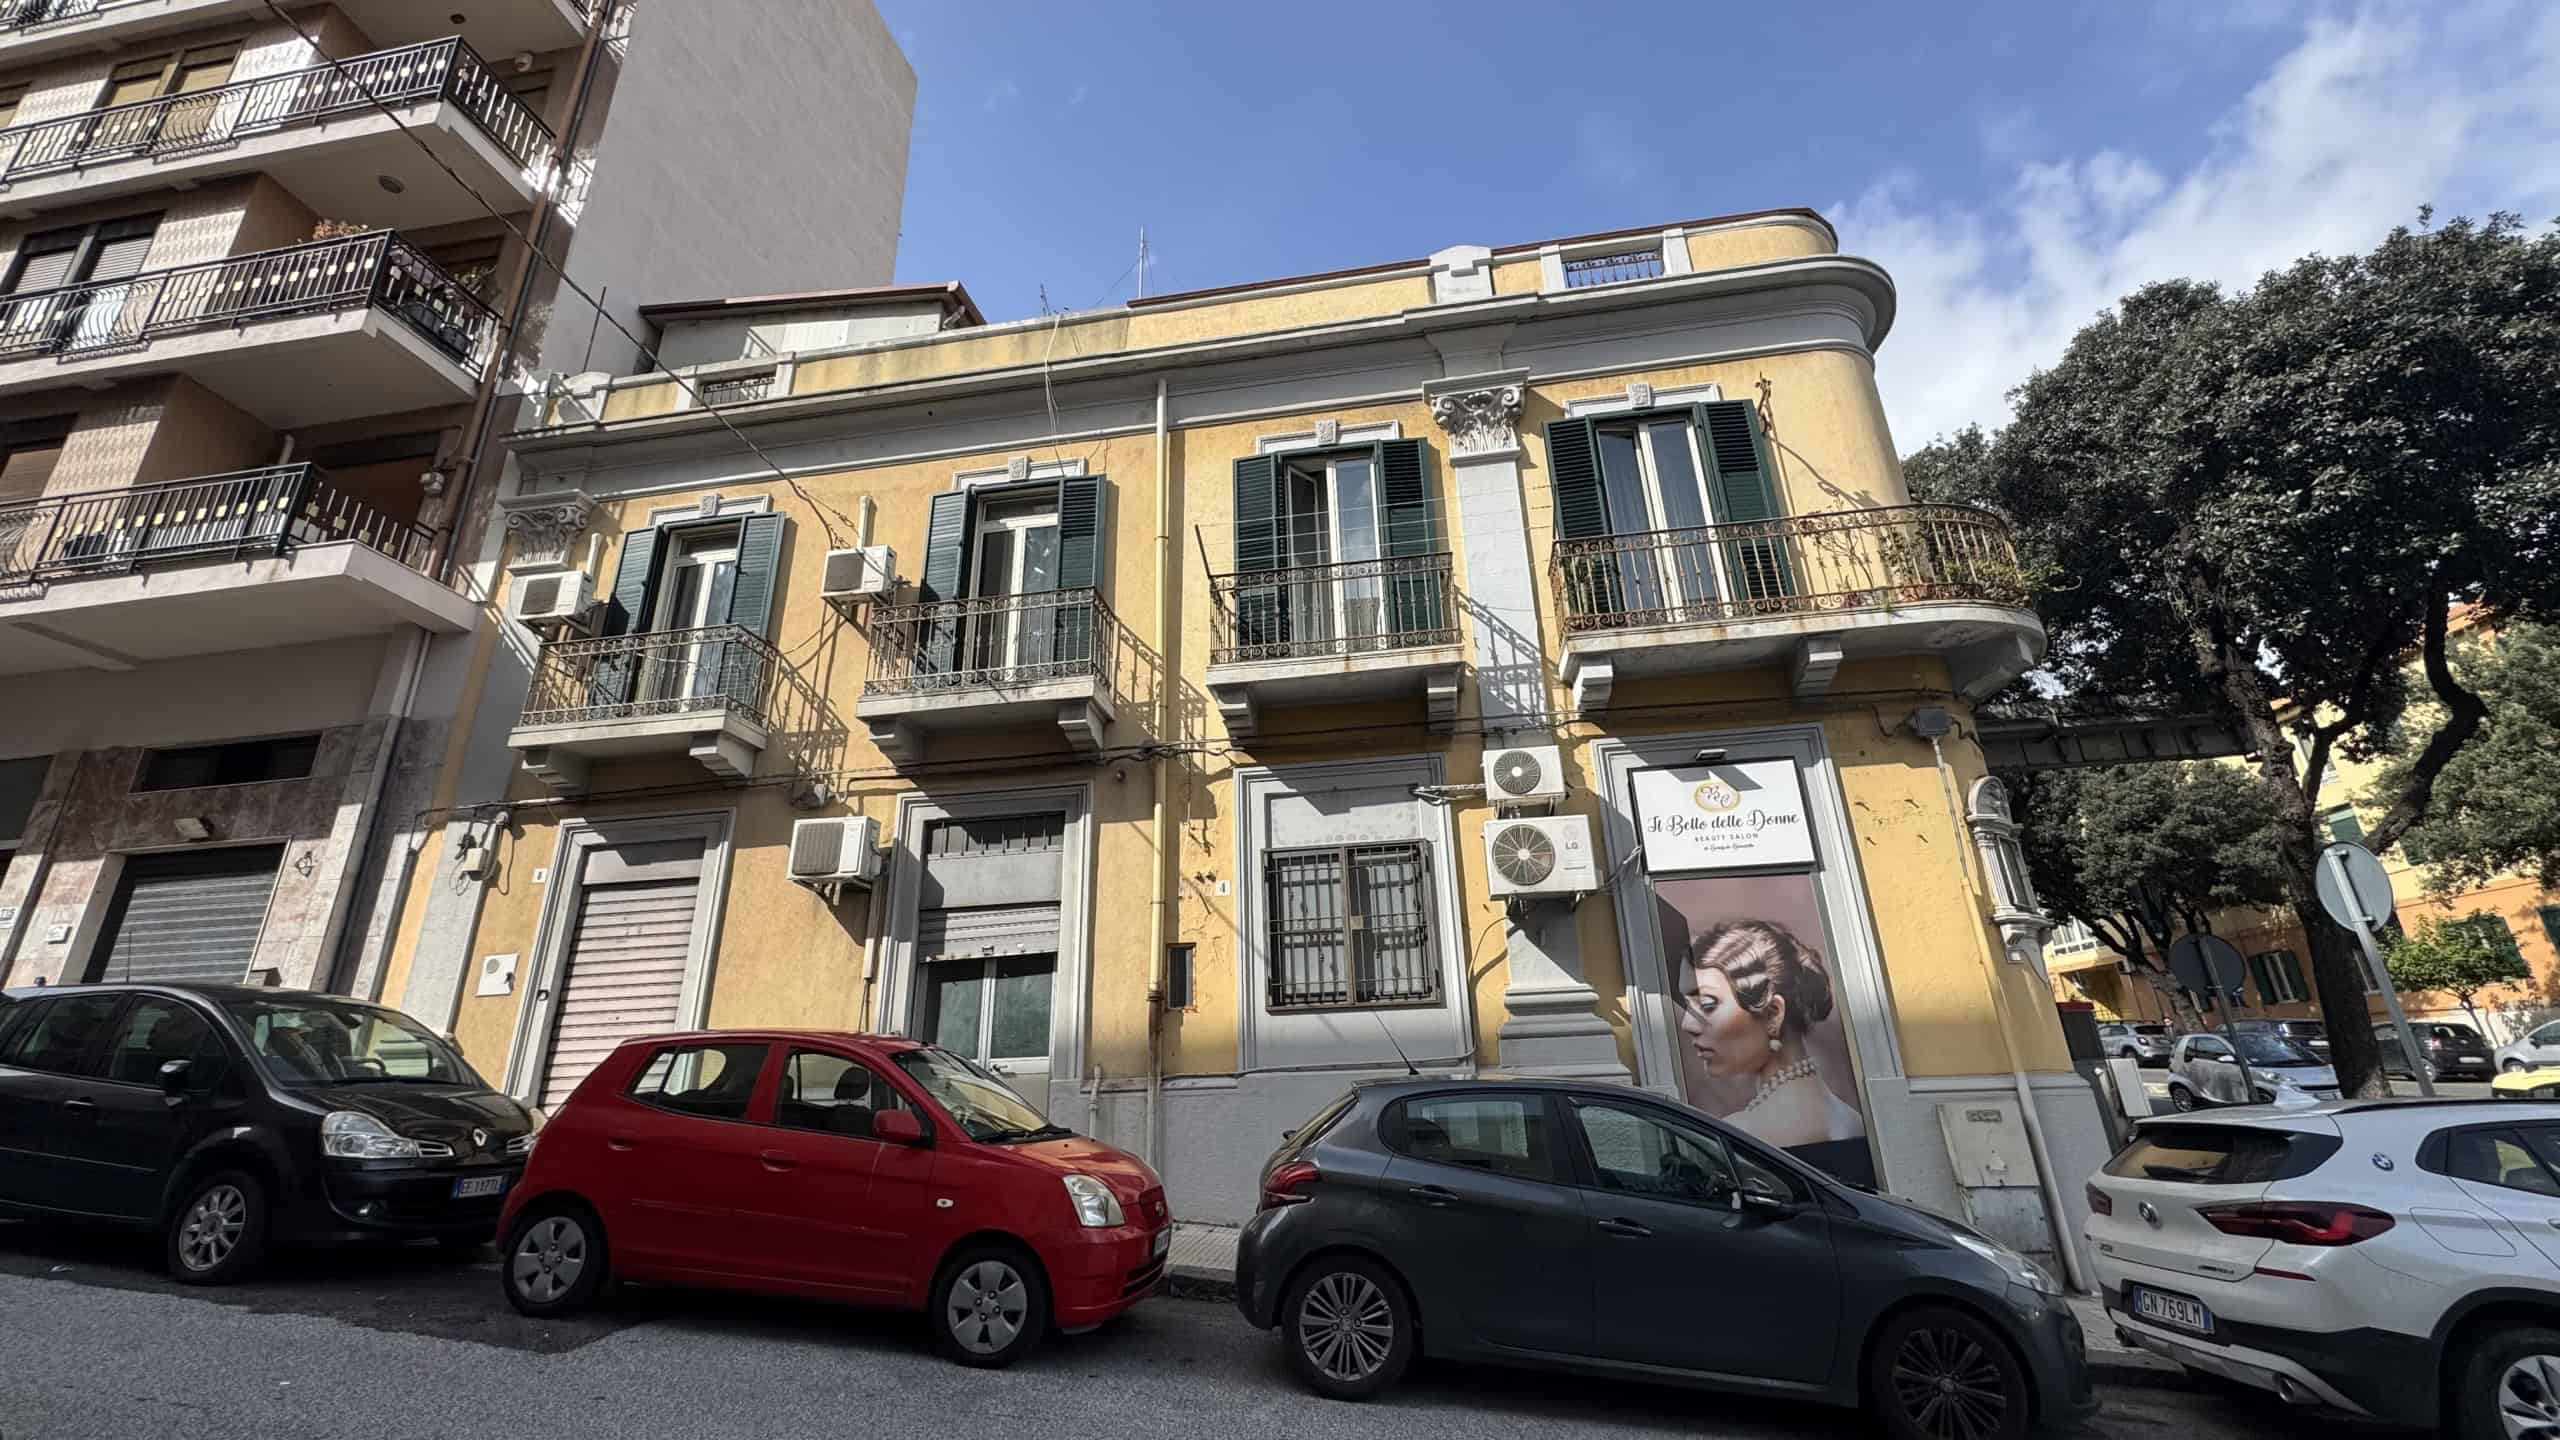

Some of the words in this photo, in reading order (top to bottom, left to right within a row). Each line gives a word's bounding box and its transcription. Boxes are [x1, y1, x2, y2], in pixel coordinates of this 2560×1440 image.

[1711, 814, 1744, 829] delle
[1745, 808, 1800, 832] Donne
[1694, 834, 1726, 842] BEAUTY
[1729, 832, 1759, 841] SALON
[2160, 1296, 2201, 1326] 769LM
